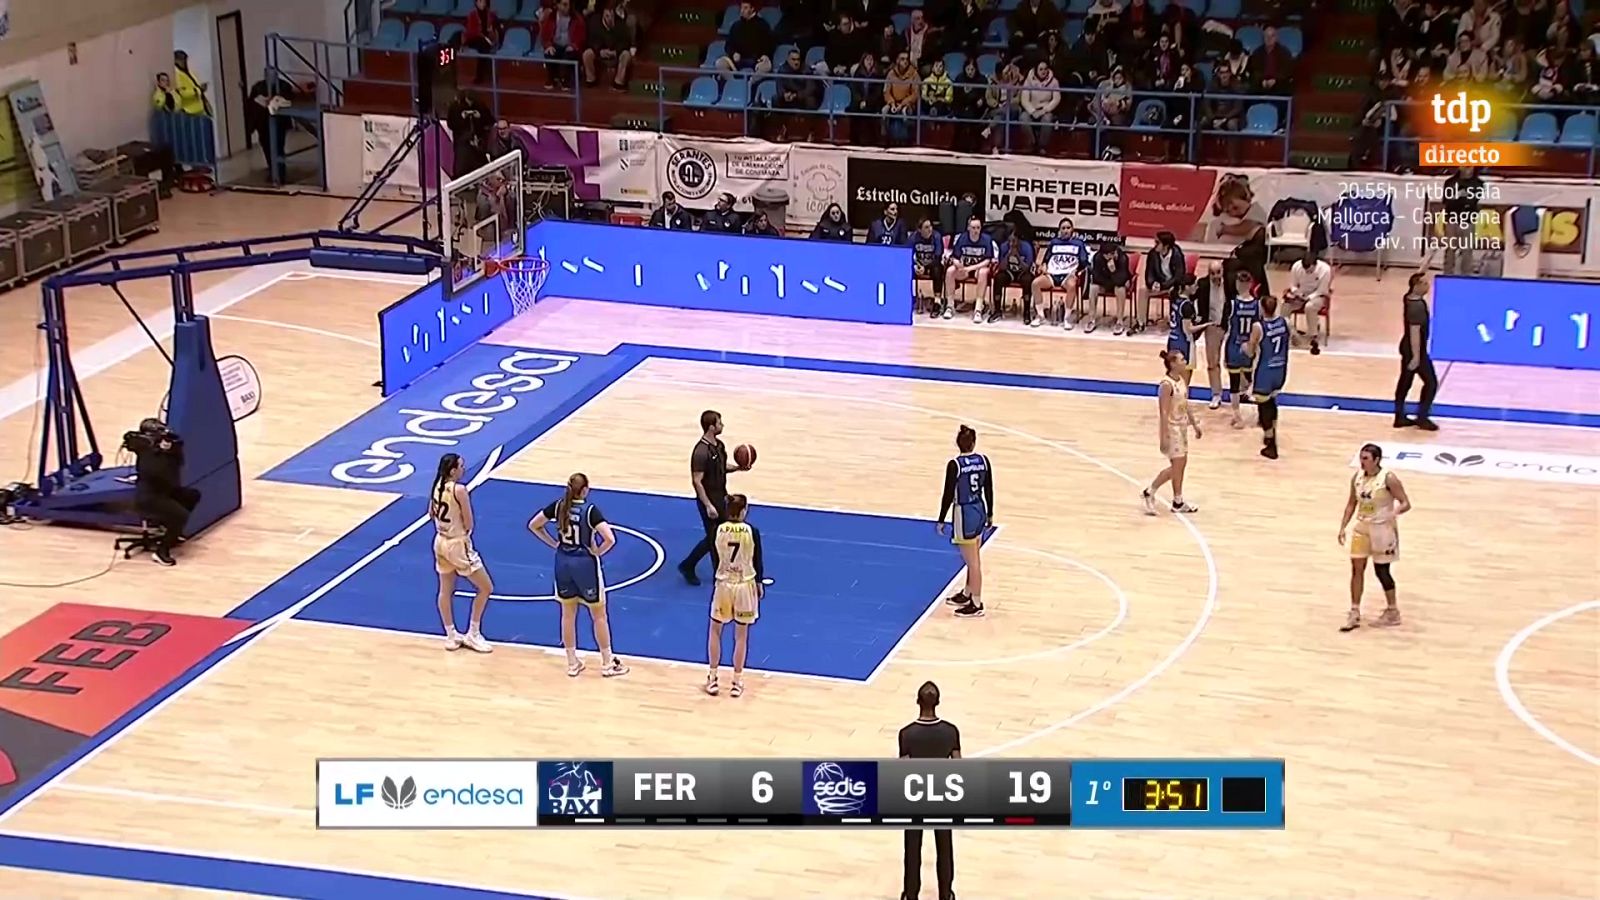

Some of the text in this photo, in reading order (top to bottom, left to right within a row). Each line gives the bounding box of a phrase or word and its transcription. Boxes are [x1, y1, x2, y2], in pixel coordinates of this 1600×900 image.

[671, 149, 712, 170] SERANTES
[856, 186, 958, 206] Estrella Galicia
[990, 176, 1120, 197] FERRETERIA
[990, 194, 1120, 217] MARCOS
[1272, 336, 1282, 354] 7
[331, 350, 580, 484] endesa
[970, 473, 980, 492] 5
[728, 541, 741, 563] 7
[0, 619, 173, 696] FEB
